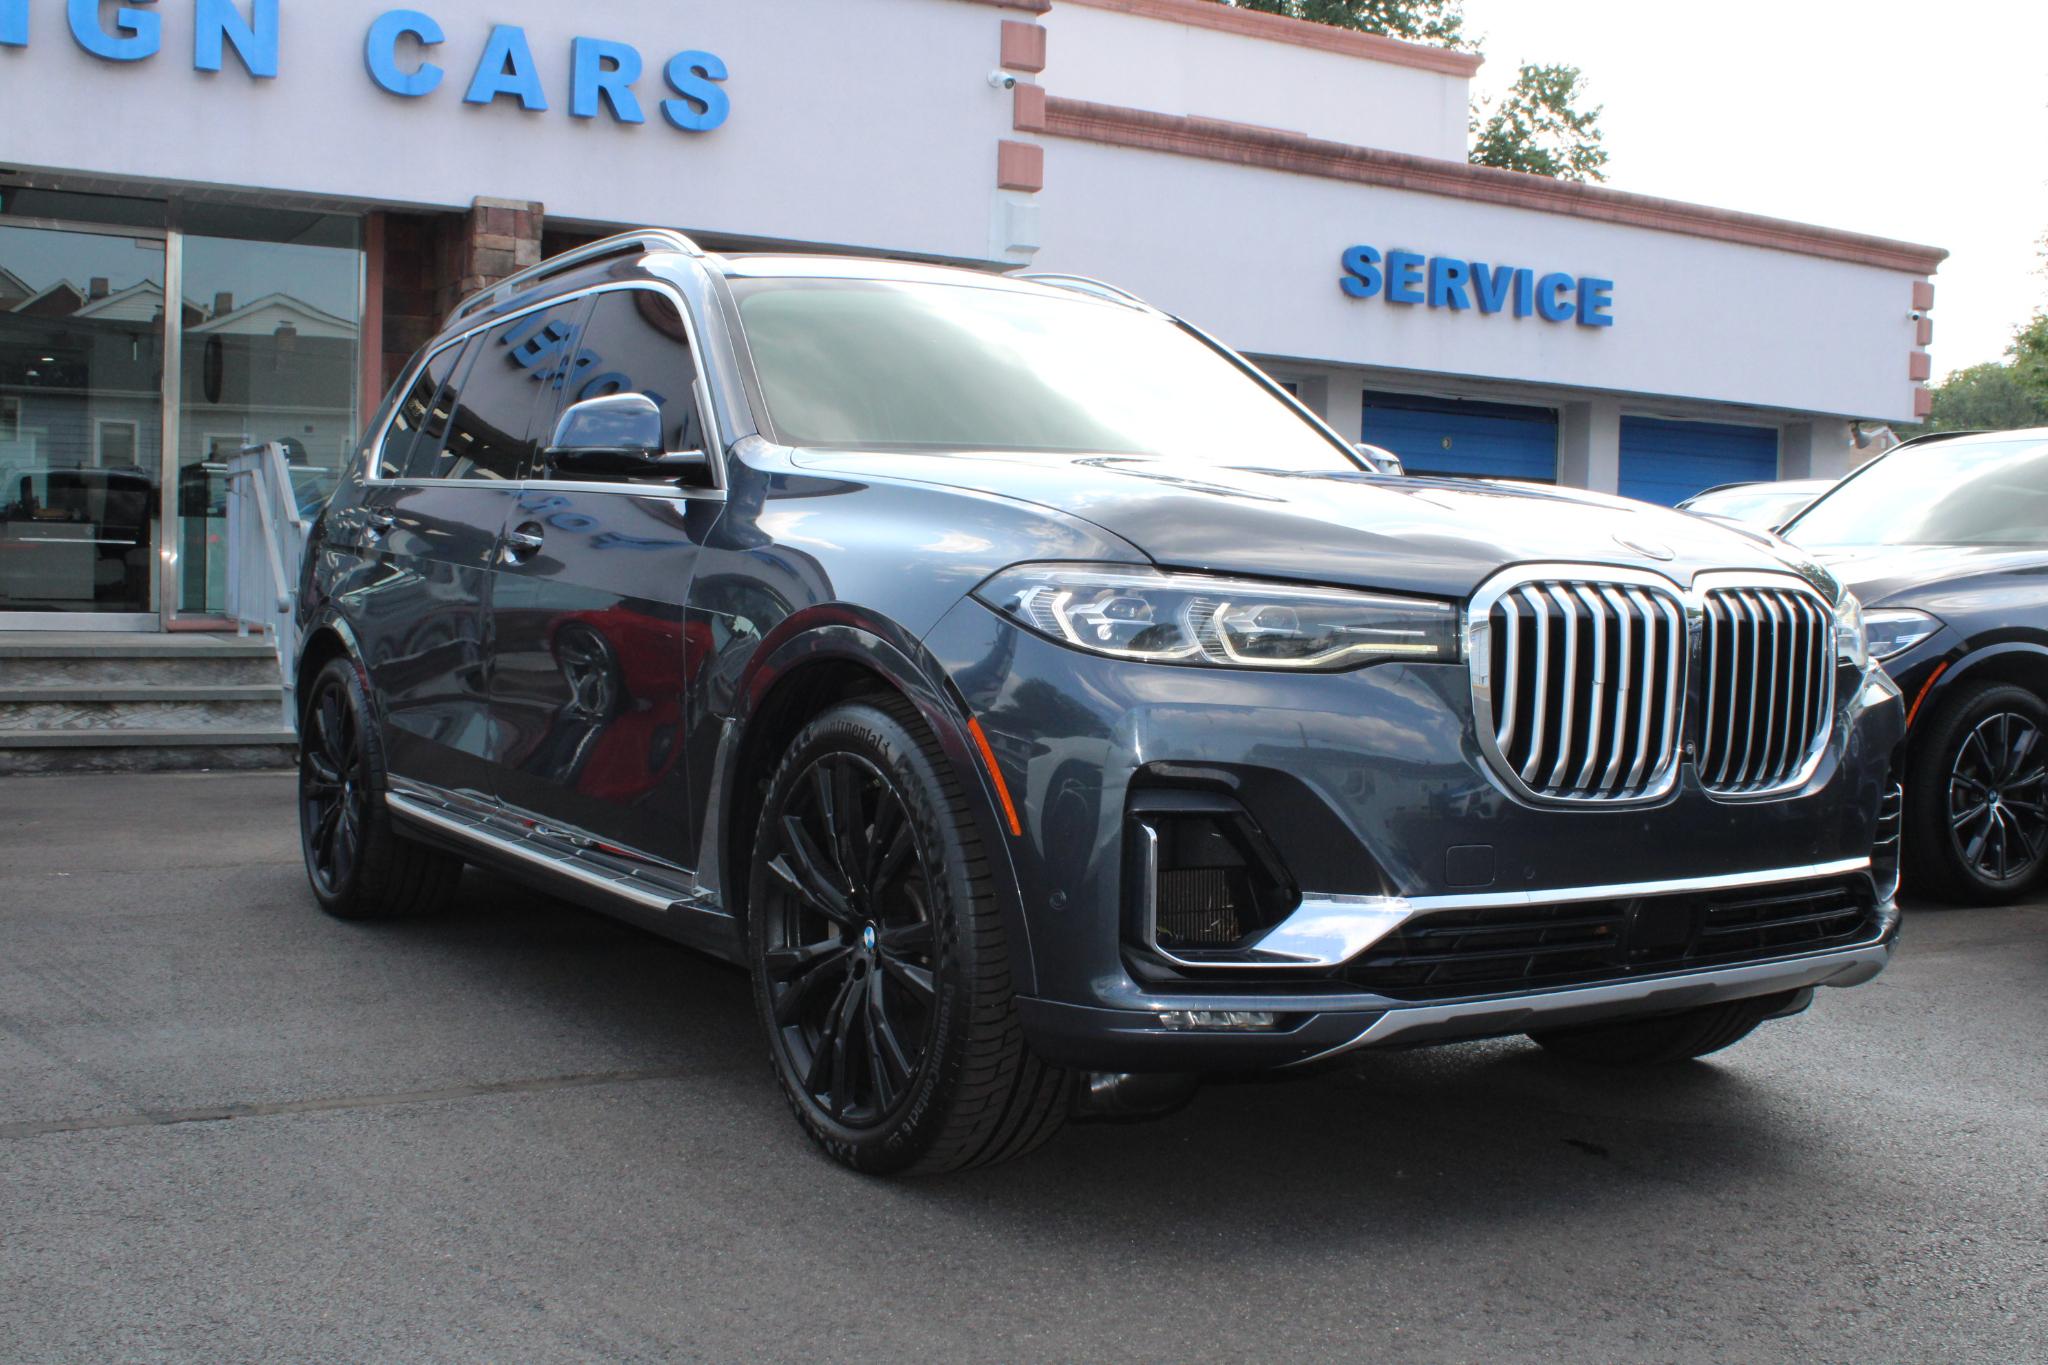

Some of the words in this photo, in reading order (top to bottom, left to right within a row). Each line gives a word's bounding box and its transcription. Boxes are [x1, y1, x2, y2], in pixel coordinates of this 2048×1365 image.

[364, 9, 731, 133] CARS
[1340, 244, 1613, 327] SERVICE
[817, 719, 884, 751] ontinental
